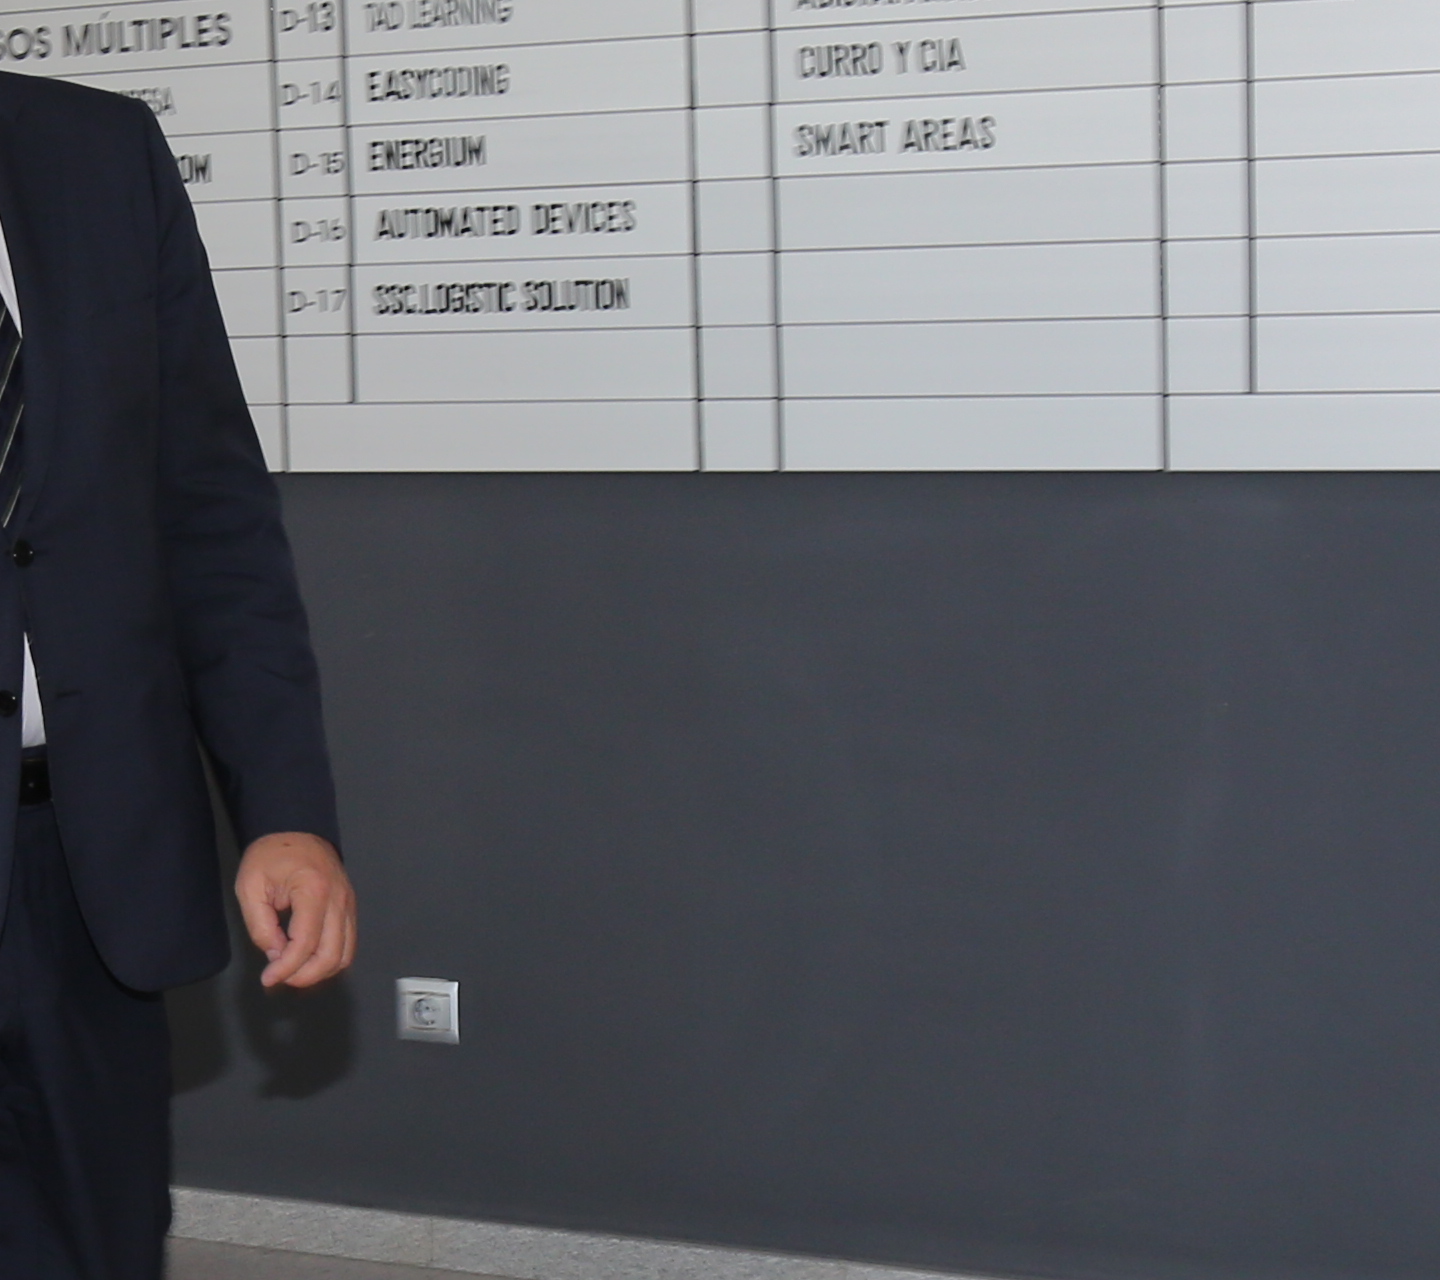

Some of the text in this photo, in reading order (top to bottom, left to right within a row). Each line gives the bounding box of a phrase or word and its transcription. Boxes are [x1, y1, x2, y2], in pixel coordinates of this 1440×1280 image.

[63, 11, 233, 57] MÚLTIPLES
[362, 1, 406, 33] TAD
[798, 37, 967, 79] CURRO Y CIA
[365, 64, 511, 103] EASYCODING
[366, 135, 486, 172] ENERGIUM
[793, 115, 997, 157] SMART AREAS
[373, 200, 637, 241] AUTOMATED DEVICES
[522, 278, 631, 313] SOLUTION
